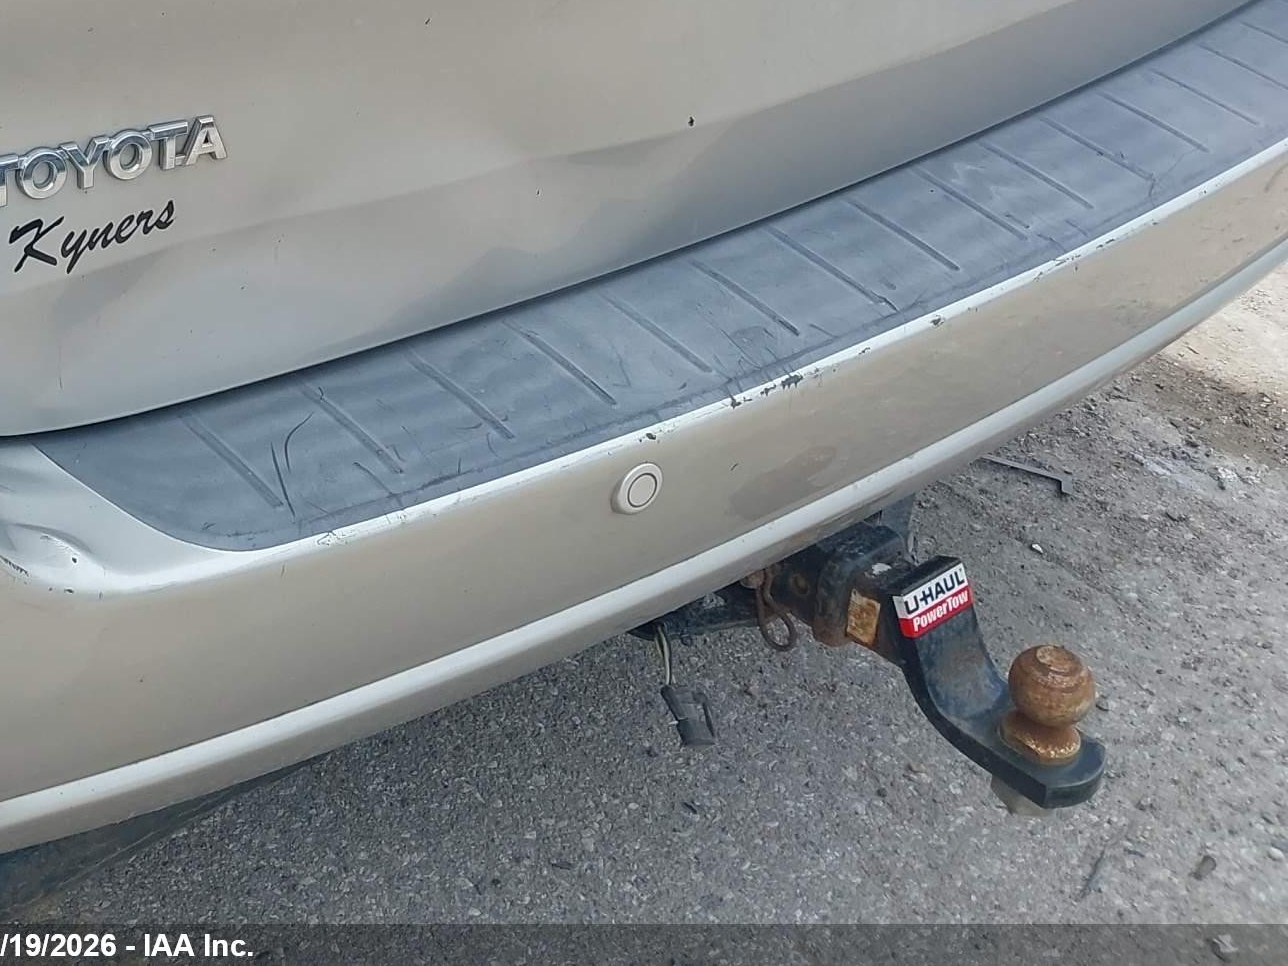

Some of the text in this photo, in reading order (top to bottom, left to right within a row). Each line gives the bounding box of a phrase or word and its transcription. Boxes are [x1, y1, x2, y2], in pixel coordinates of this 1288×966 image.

[8, 199, 176, 275] Kyners
[904, 570, 966, 615] U-HAUL
[912, 590, 970, 632] PowerTow
